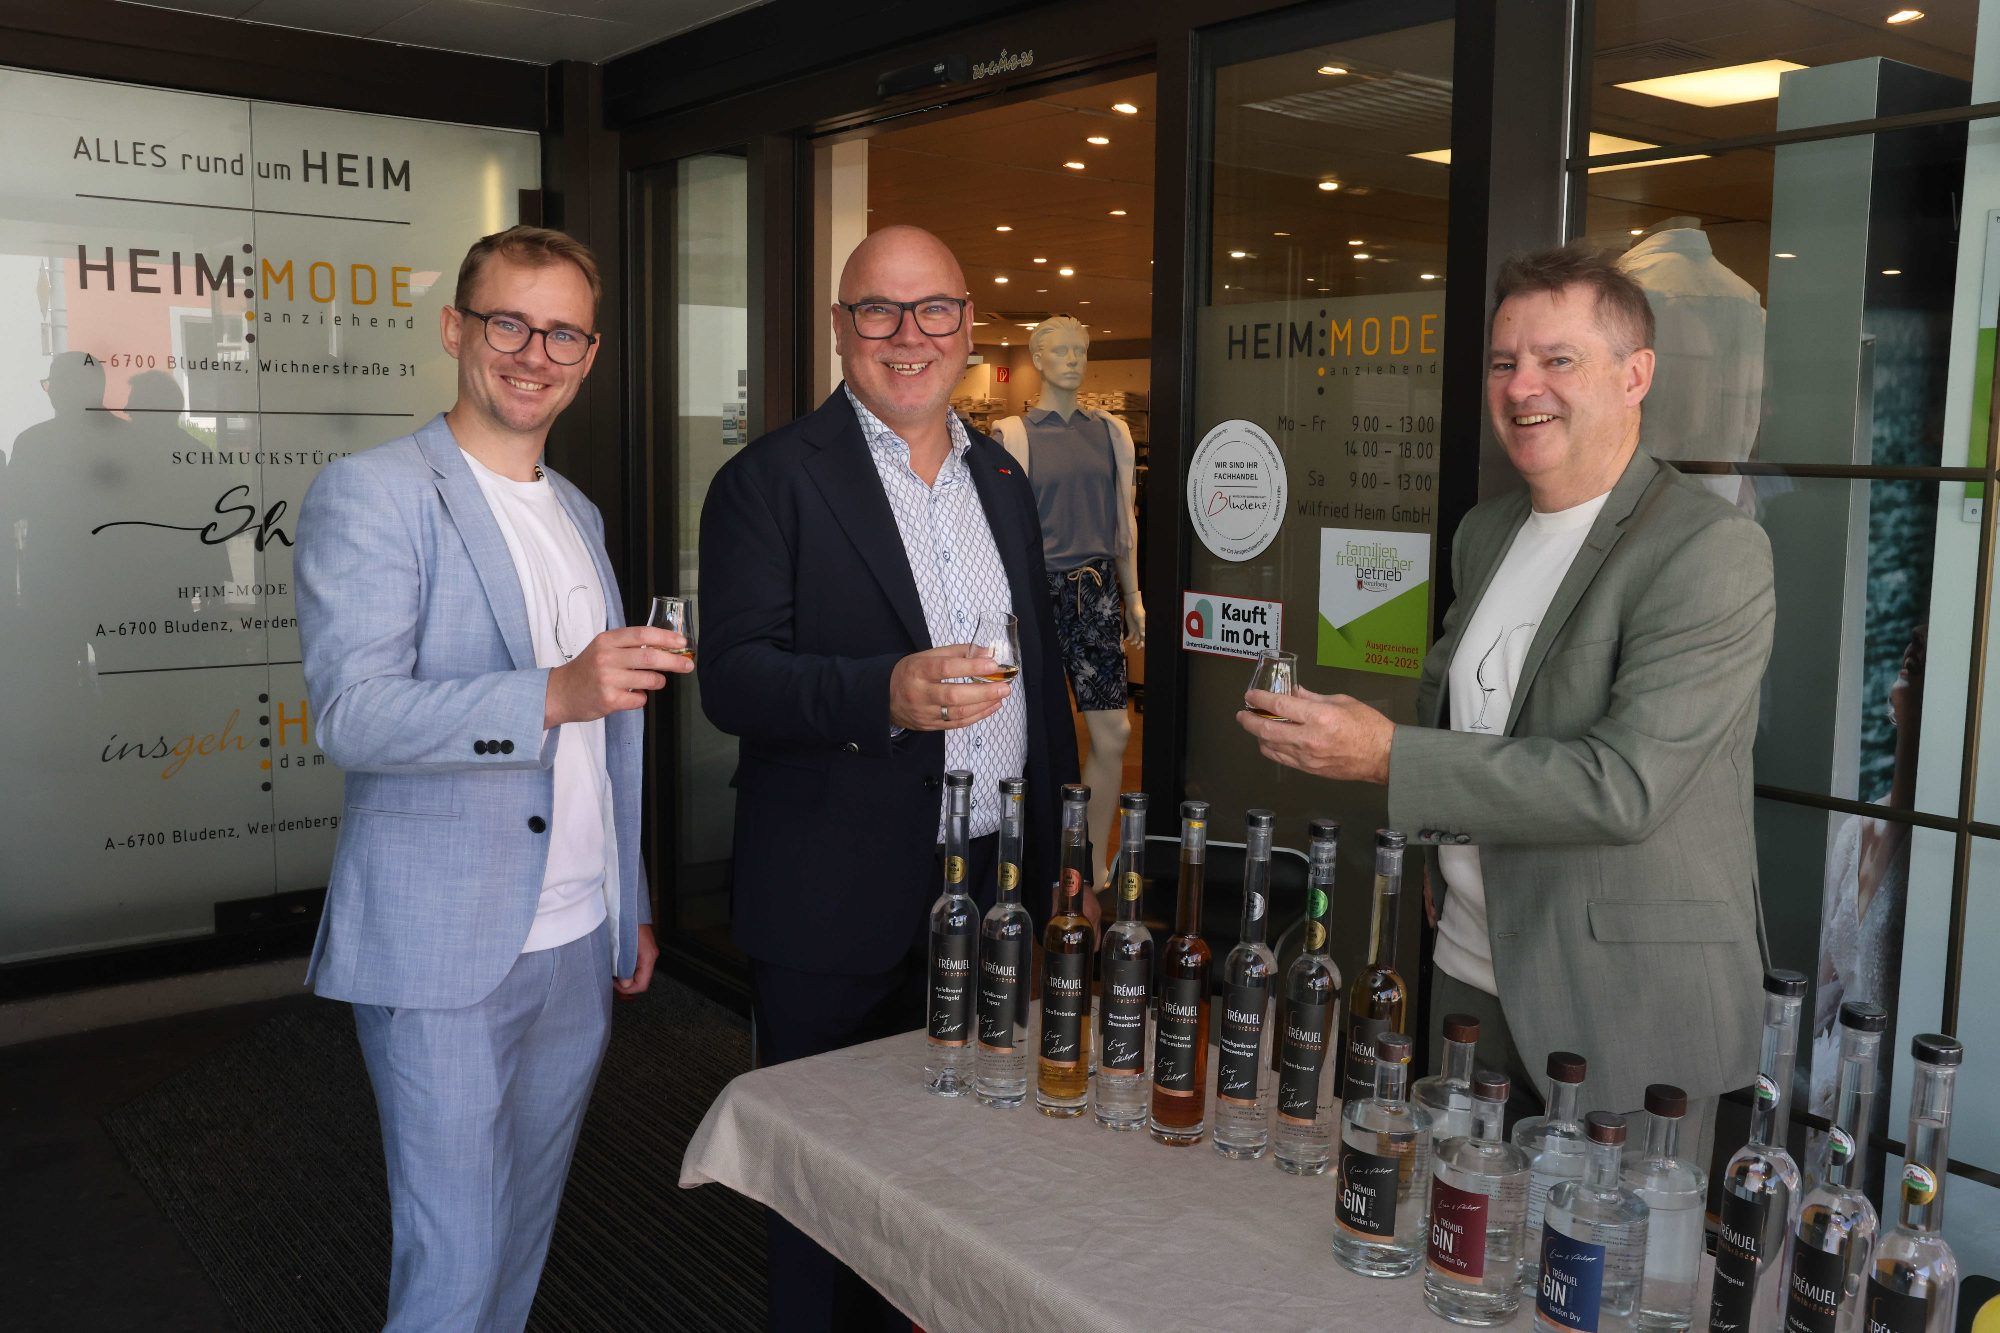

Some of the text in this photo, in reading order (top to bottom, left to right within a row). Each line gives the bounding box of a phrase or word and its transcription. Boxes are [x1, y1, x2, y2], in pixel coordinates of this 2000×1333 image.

[73, 136, 411, 192] ALLES rund um HEIM
[78, 244, 412, 308] HEIM MODE
[263, 311, 414, 330] anziehend
[1227, 314, 1440, 360] HEIM MODE
[84, 353, 416, 377] A-6700 Bludenz, Wichnerstraße 31
[1330, 361, 1438, 376] anziehend
[1277, 415, 1296, 432] Mo
[1312, 415, 1327, 431] Fr
[172, 449, 352, 466] SCHMUCKSTÜC
[1214, 461, 1228, 469] WIR
[1229, 461, 1244, 469] SIND
[1214, 472, 1259, 481] FACHHANDEL
[1307, 470, 1326, 487] Sa
[1297, 499, 1350, 519] Wilfried
[1354, 502, 1386, 521] Heim
[1391, 505, 1431, 524] GmbH
[1345, 540, 1398, 559] familien
[1335, 550, 1415, 571] freundlicher
[1356, 563, 1402, 582] betrieb
[178, 583, 288, 600] HEIM-MODE
[1221, 602, 1267, 626] Kauft
[96, 615, 298, 637] A-6700 Bludenz, Werden
[1221, 623, 1240, 643] im
[1243, 628, 1270, 649] Ort
[1364, 640, 1419, 654] Ausgezeichnet
[1364, 653, 1419, 670] 2024-2025
[278, 700, 308, 746] H
[279, 752, 325, 769] dam
[105, 814, 342, 851] A-6700 Bludenz, Werdenberg
[938, 957, 970, 970] TRÉMUEL
[985, 961, 1017, 976] TRÉMUEL
[1050, 976, 1082, 990] TRÉMUEL
[1113, 984, 1146, 997] TRÉMUEL
[1165, 1002, 1197, 1018] TRÉMUEL
[1227, 1008, 1260, 1025] TRÉMUEL
[1288, 1026, 1321, 1043] TRÉMUEL
[1343, 1188, 1367, 1216] GIN
[1350, 1213, 1380, 1230] London Dry
[1432, 1223, 1454, 1254] GIN
[1720, 1222, 1757, 1252] RÉMUEL
[1438, 1250, 1468, 1269] London Dry
[1543, 1273, 1567, 1307] GIN
[1792, 1272, 1837, 1306] TRÉMUEL
[1549, 1301, 1581, 1324] London Dry
